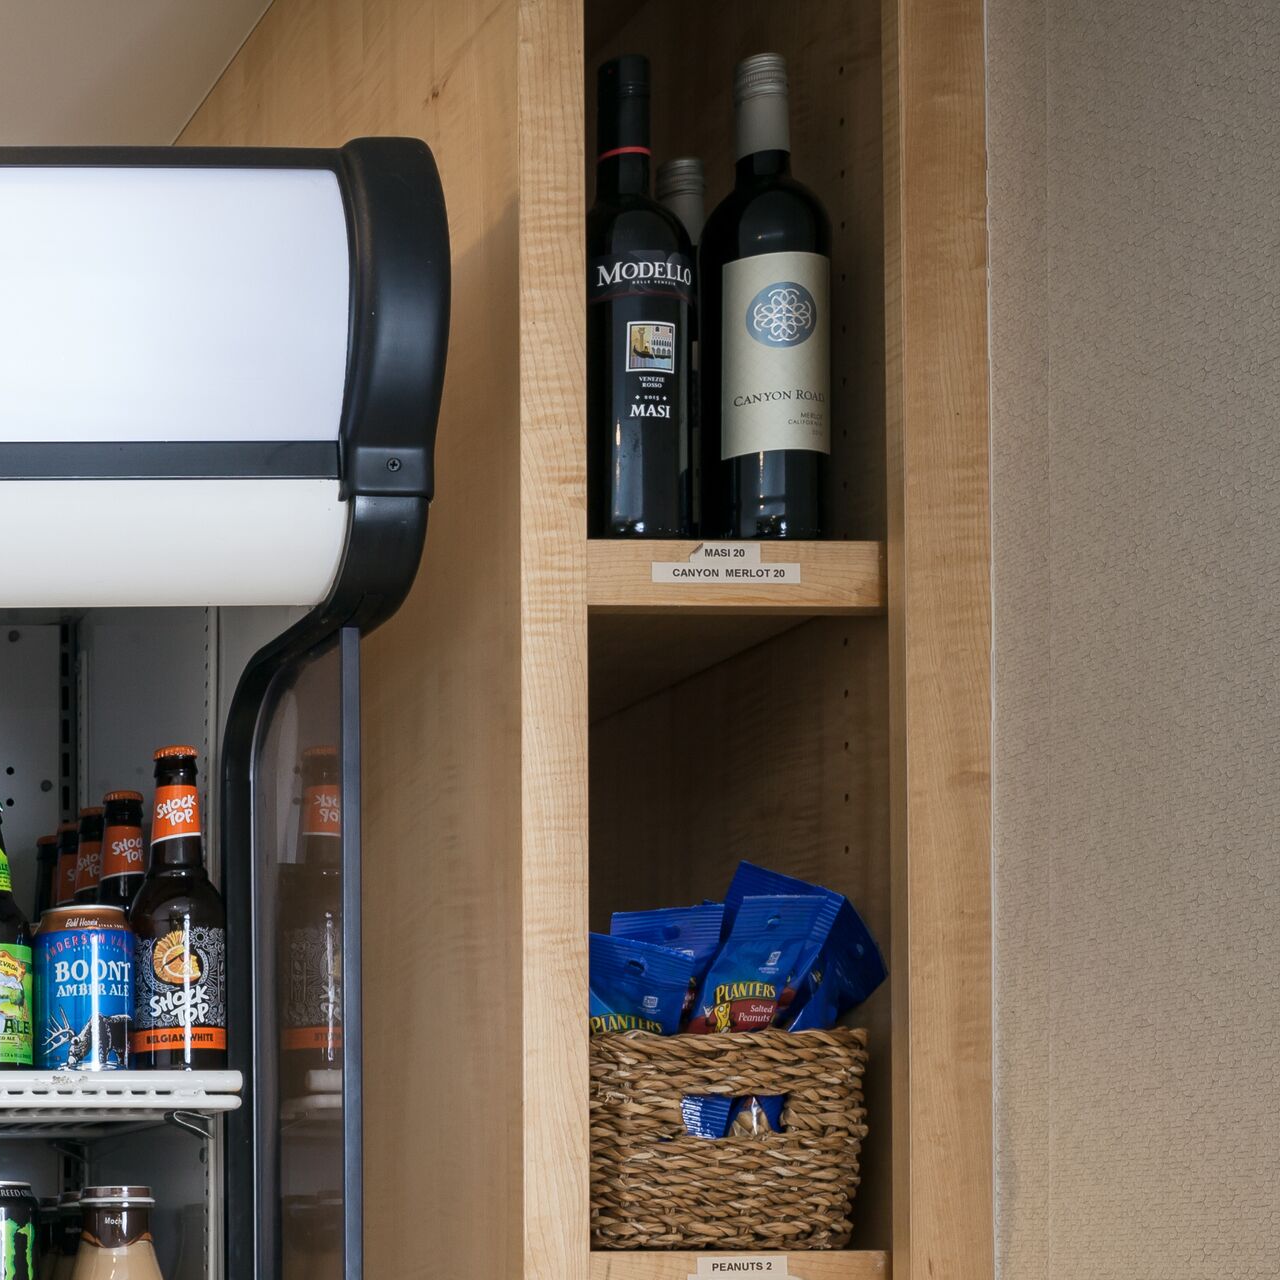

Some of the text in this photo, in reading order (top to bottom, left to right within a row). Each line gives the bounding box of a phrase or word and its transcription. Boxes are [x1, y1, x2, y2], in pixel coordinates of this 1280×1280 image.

[597, 261, 691, 287] MODELLO
[733, 390, 792, 407] CANYON
[630, 404, 670, 419] MASI
[704, 548, 745, 558] MASI 20
[672, 568, 786, 579] CANYON MERLOT 20
[156, 794, 195, 819] SHOCK
[55, 959, 130, 982] BOONT
[715, 981, 776, 1005] PLANTERS
[150, 986, 209, 1016] SHOCK
[750, 1004, 774, 1014] Salted
[738, 1013, 771, 1024] Peanuts
[4, 1019, 30, 1034] ALE
[146, 1031, 214, 1045] BELGIAN WHITE
[712, 1261, 773, 1271] PEANUTS 2
